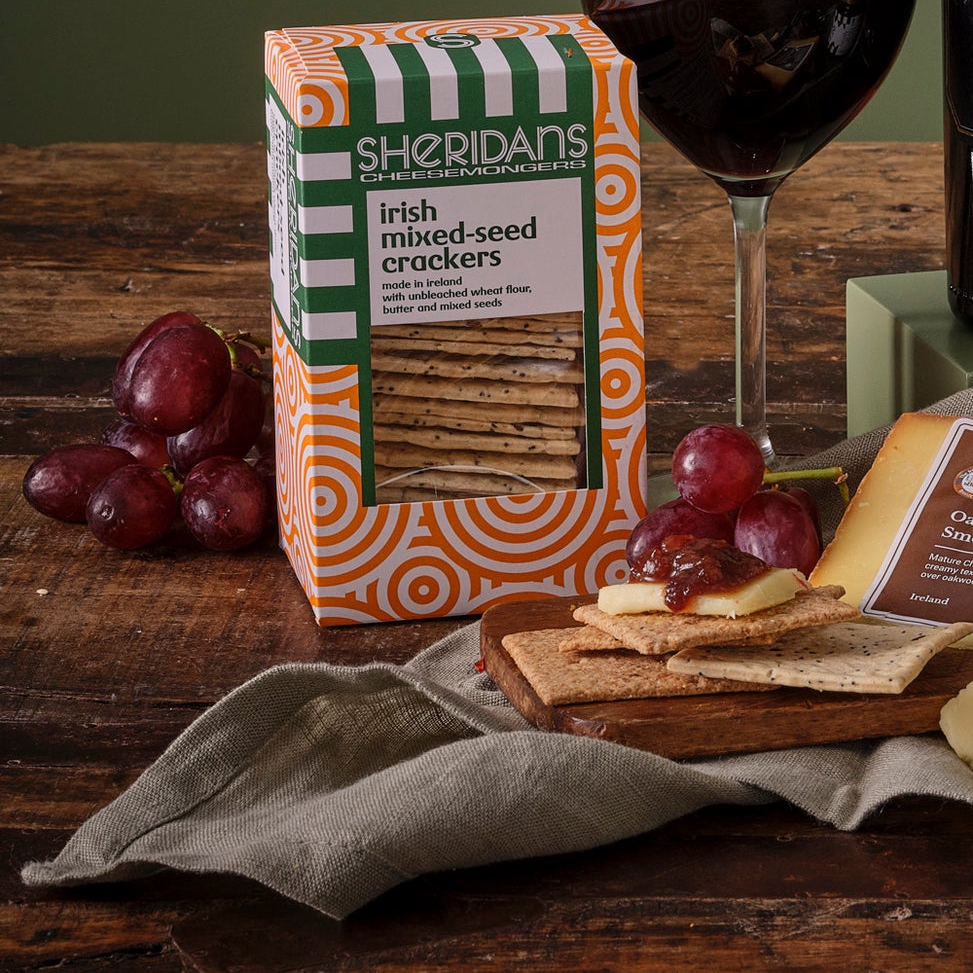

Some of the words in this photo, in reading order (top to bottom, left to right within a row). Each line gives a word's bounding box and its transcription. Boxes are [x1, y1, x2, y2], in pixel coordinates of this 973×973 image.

[359, 159, 587, 183] CHEESEMONGERS
[380, 199, 437, 224] irish
[381, 216, 537, 249] mixed-seed
[382, 247, 502, 273] crackers
[382, 280, 411, 290] made
[414, 279, 424, 288] in
[426, 276, 463, 287] ireland
[382, 292, 406, 302] with
[408, 288, 468, 301] unbleached
[470, 286, 503, 297] wheat
[506, 284, 532, 294] flour,
[382, 304, 415, 315] butter
[417, 302, 437, 312] and
[439, 300, 472, 311] mixed
[474, 298, 503, 308] seeds
[928, 553, 962, 566] Mature
[920, 571, 941, 580] over
[924, 563, 958, 575] creamy
[909, 593, 950, 605] Ireland
